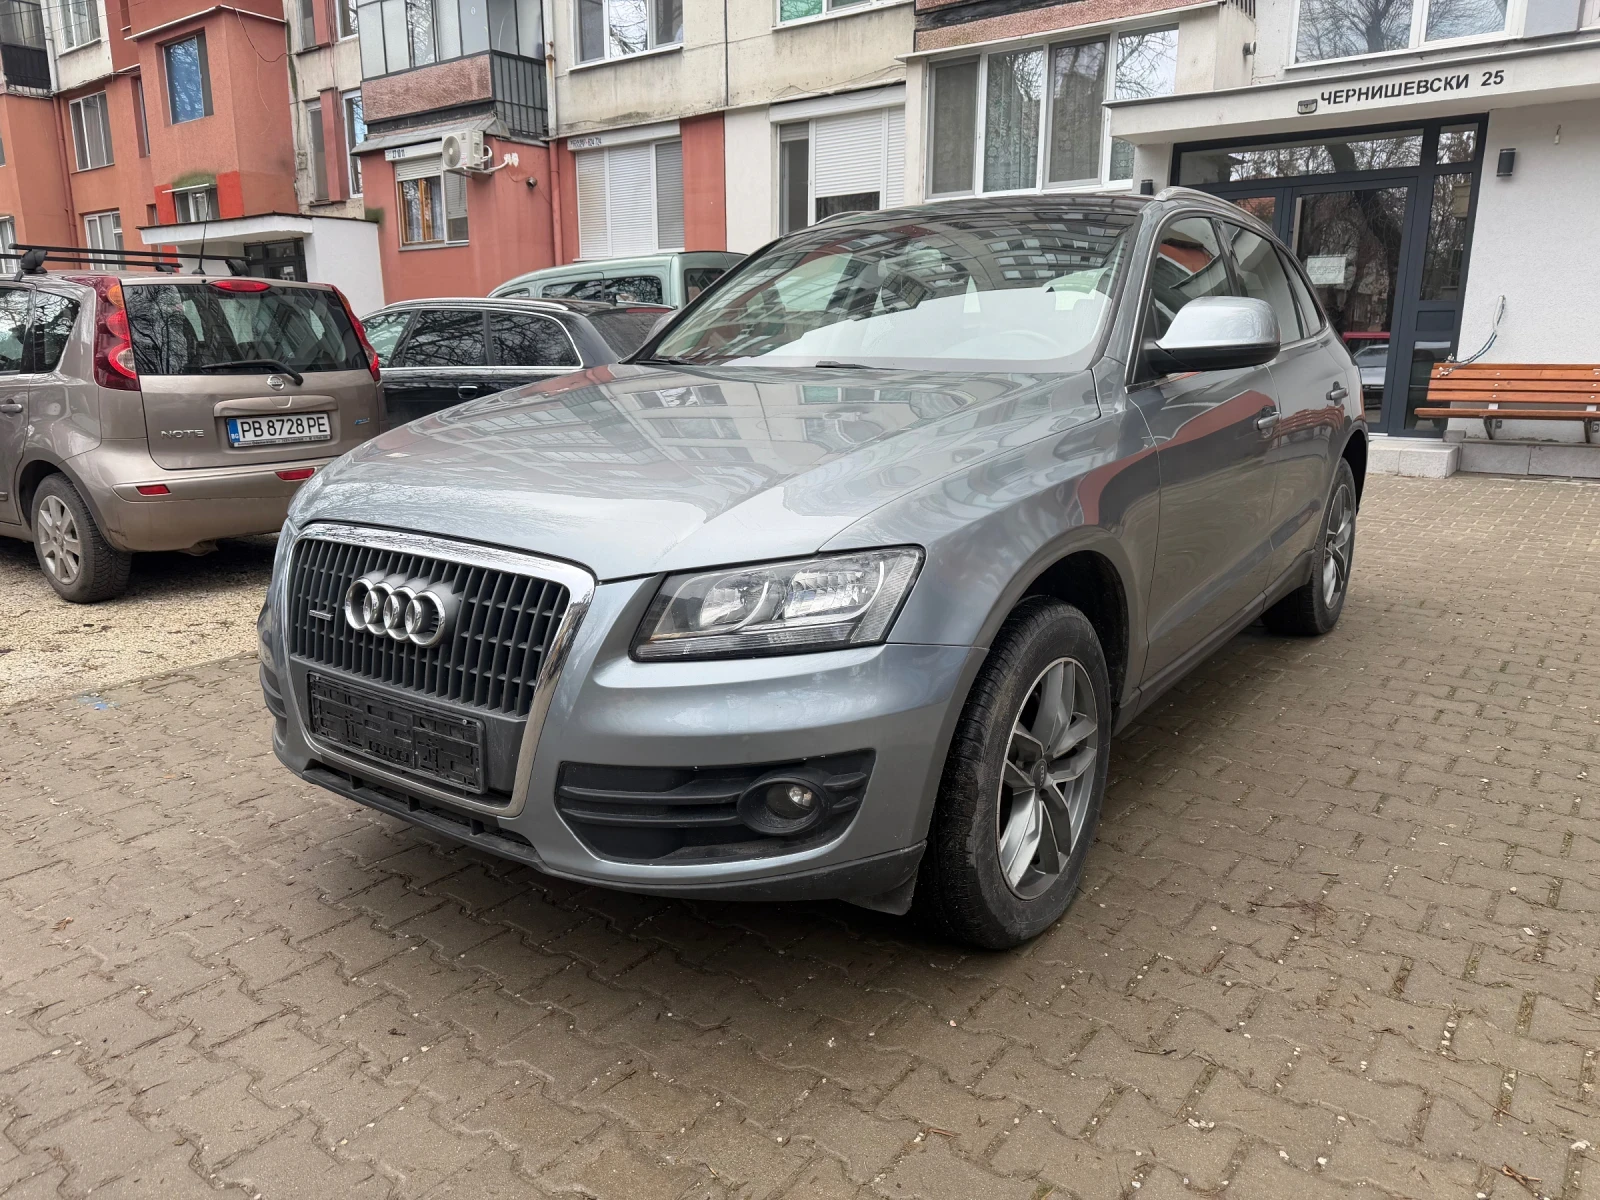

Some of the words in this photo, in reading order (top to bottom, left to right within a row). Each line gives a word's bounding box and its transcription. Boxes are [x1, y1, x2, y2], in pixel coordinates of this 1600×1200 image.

[1320, 73, 1470, 106] ЧЕРНИШЕВСКИ
[1480, 69, 1505, 87] 25
[160, 429, 205, 439] NOTE
[240, 420, 264, 439] PB
[267, 417, 305, 437] 8728
[306, 416, 328, 434] PE
